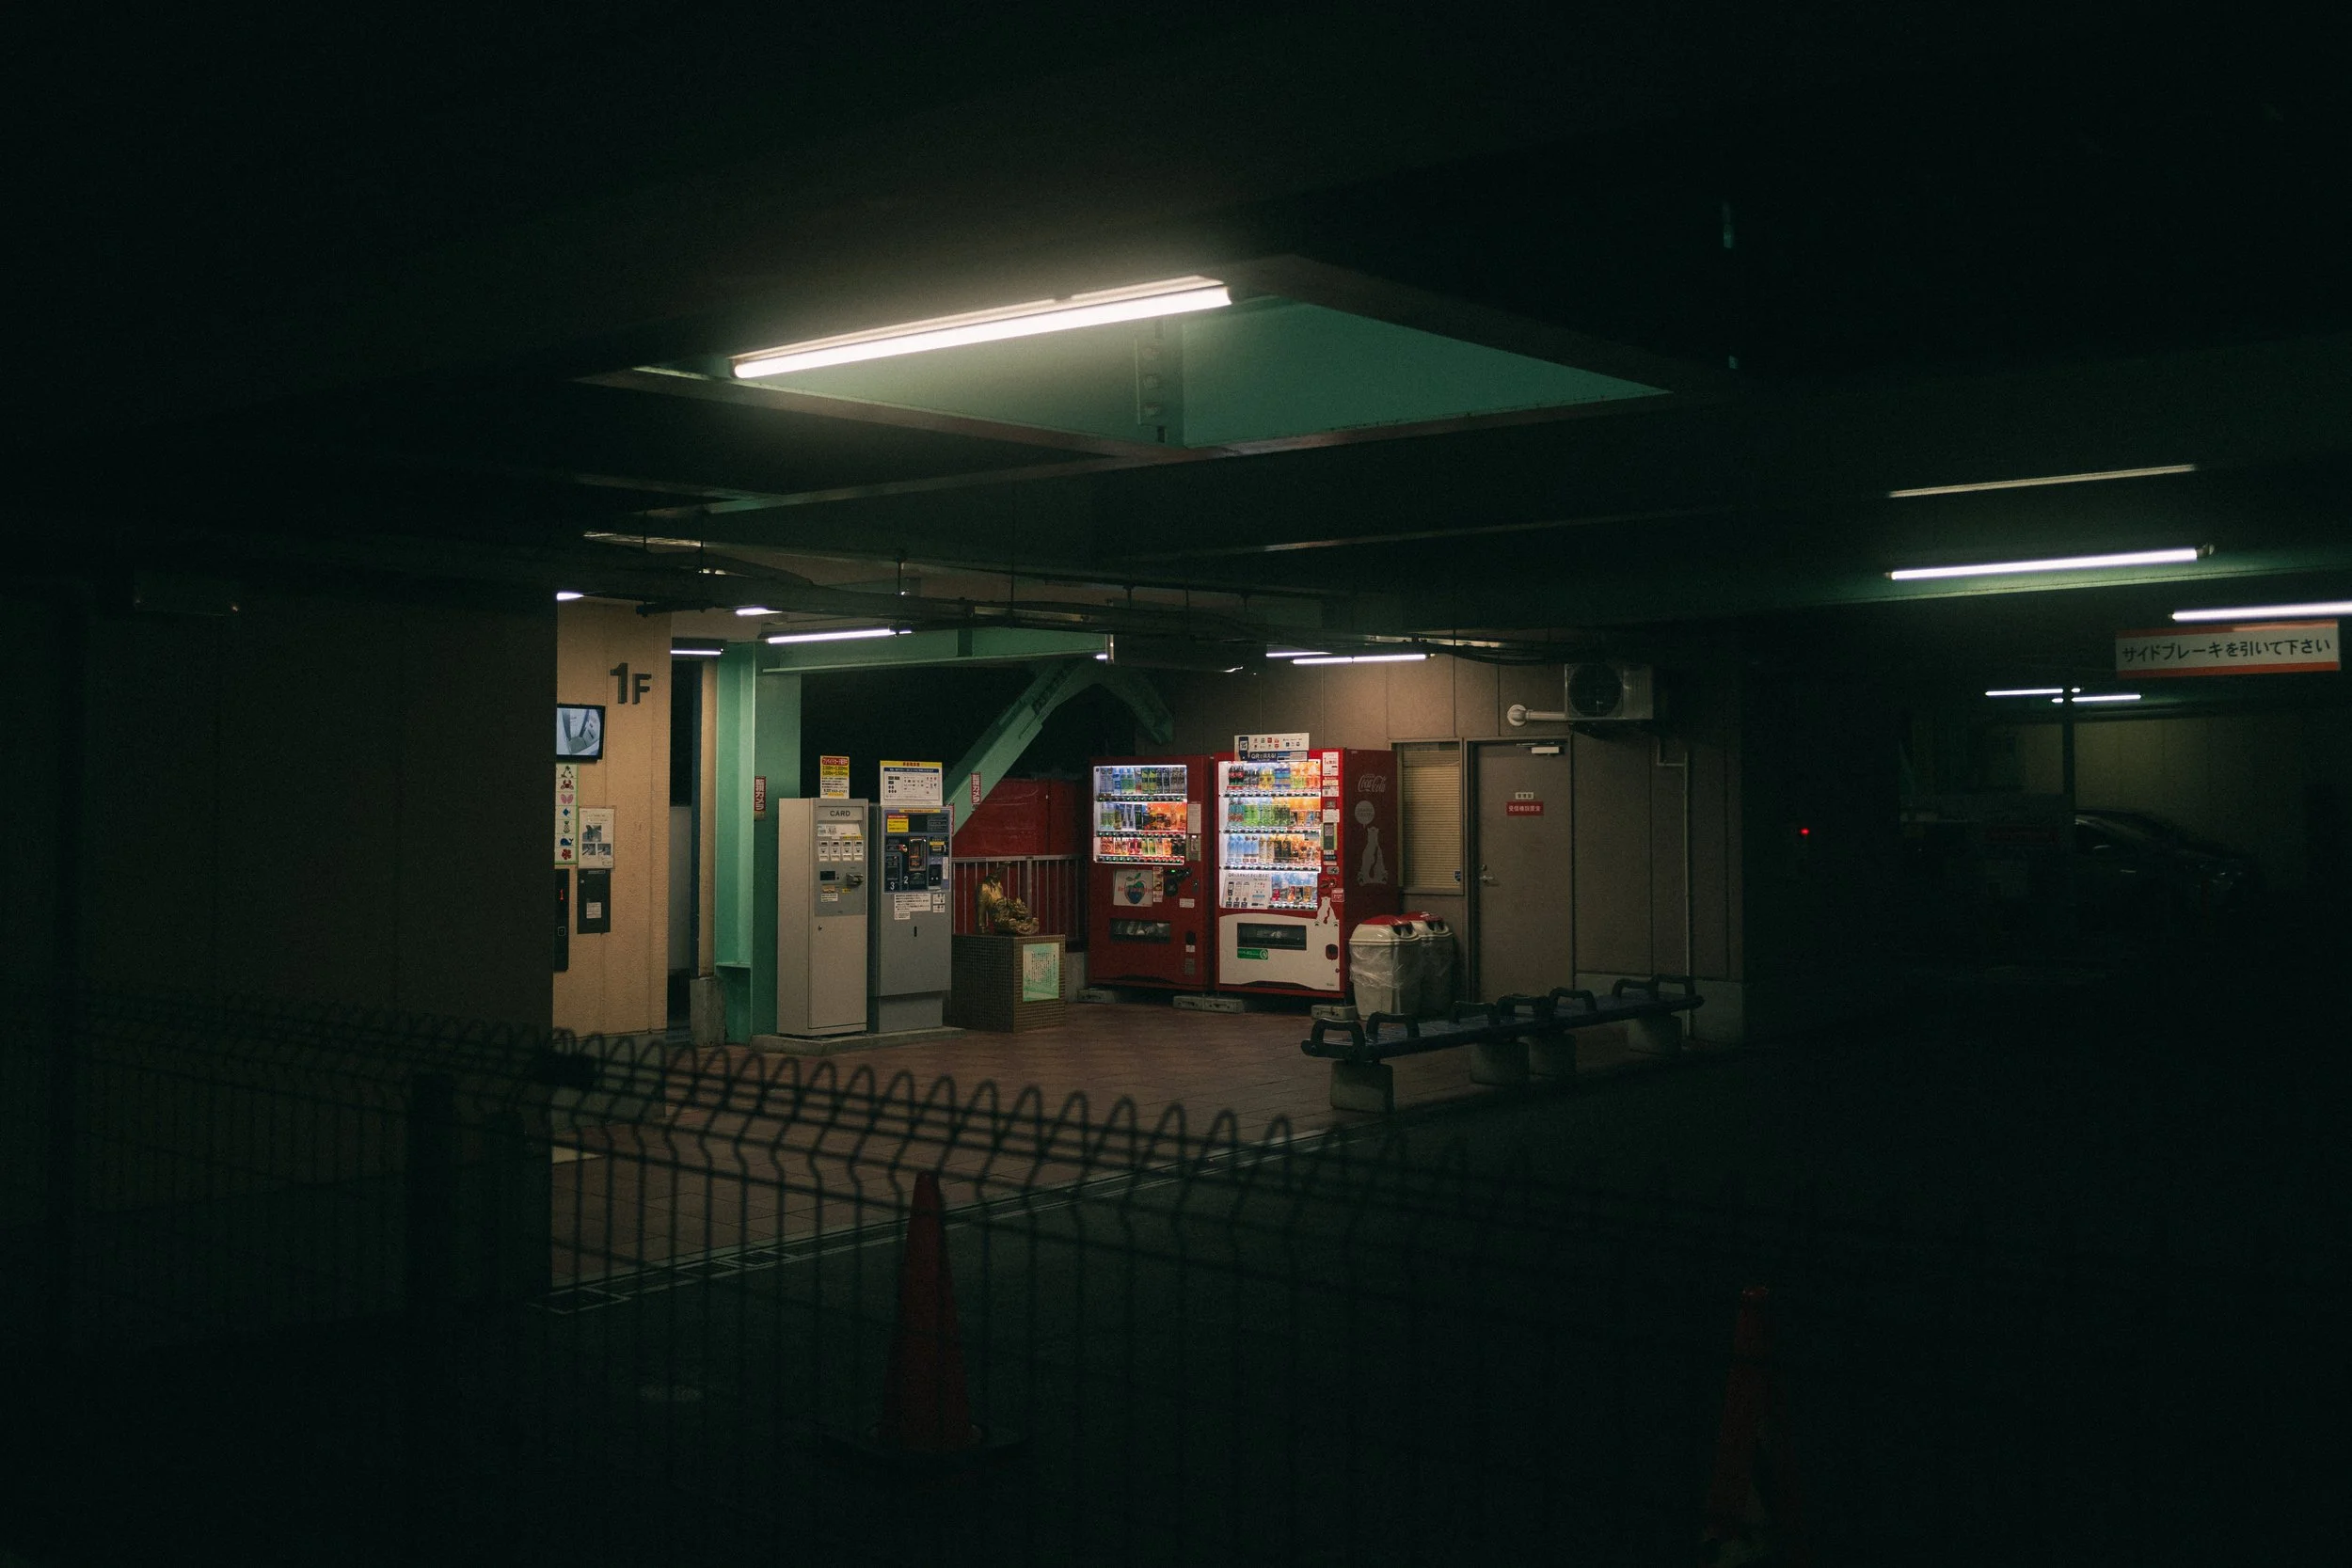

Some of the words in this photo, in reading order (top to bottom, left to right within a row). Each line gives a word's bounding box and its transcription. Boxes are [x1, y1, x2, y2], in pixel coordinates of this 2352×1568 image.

[2122, 639, 2330, 662] サイドブレーキを引いて下さい
[611, 662, 652, 705] 1F
[890, 881, 895, 890] 3
[904, 876, 909, 884] 2
